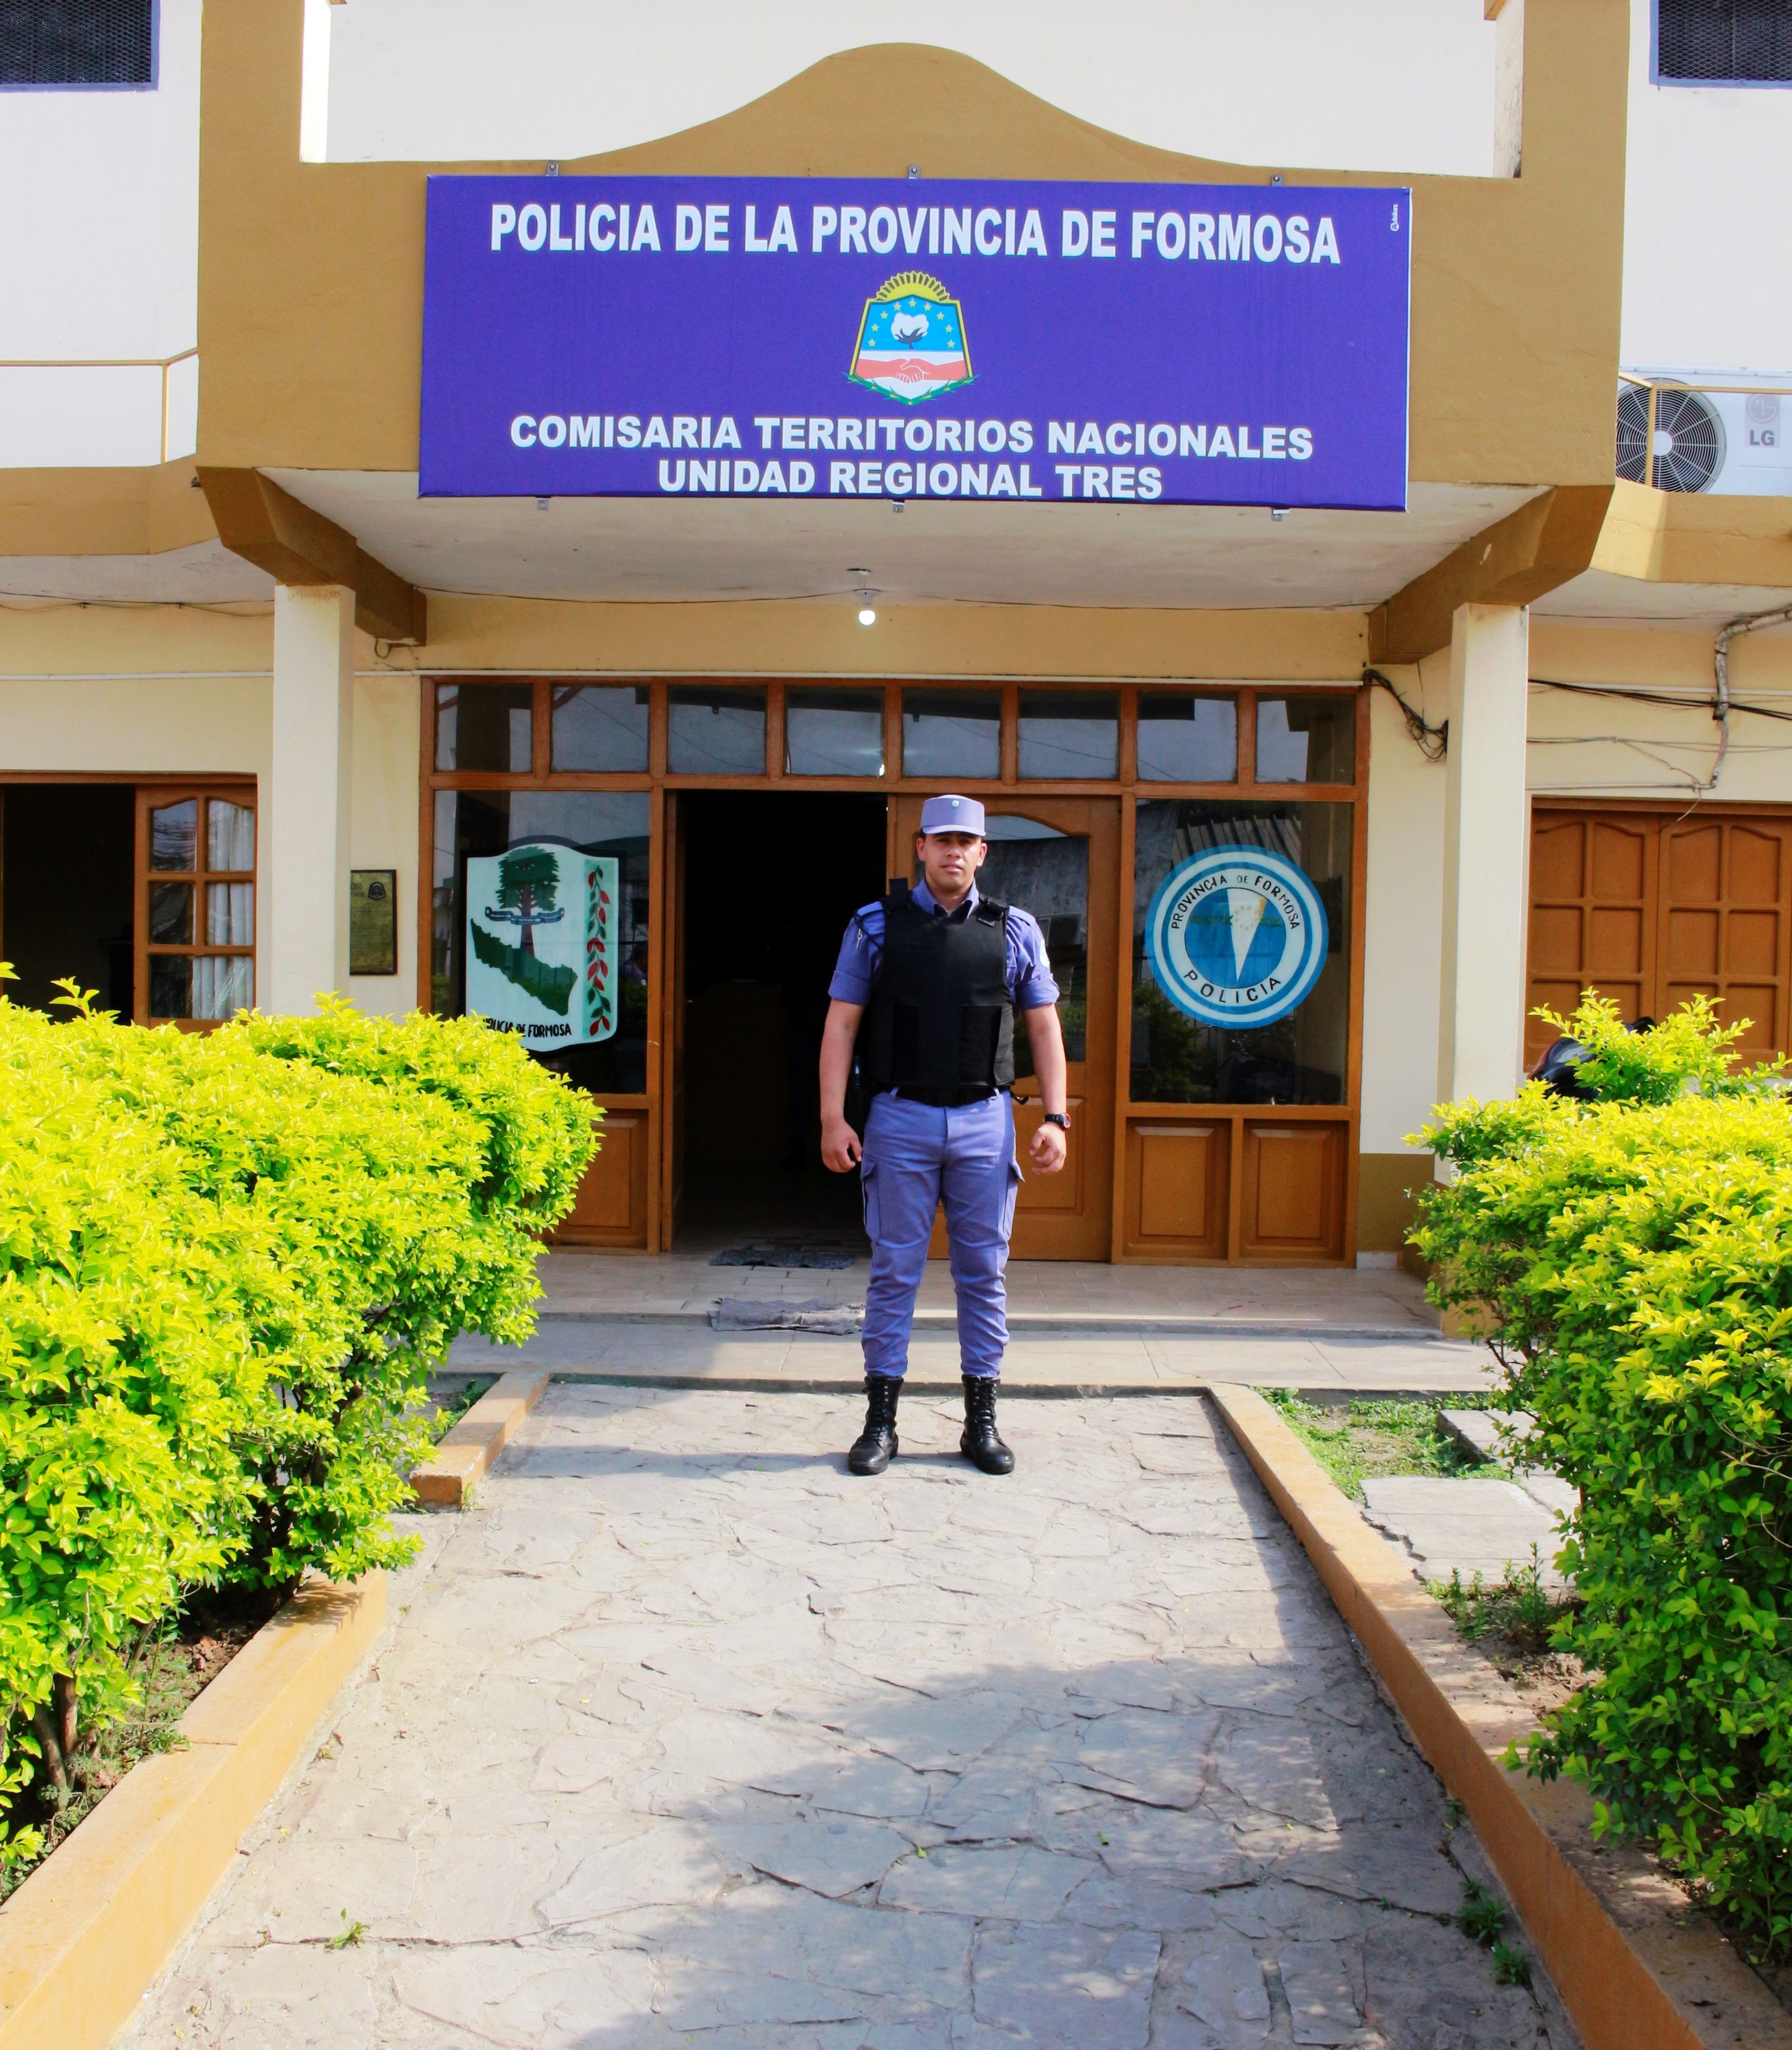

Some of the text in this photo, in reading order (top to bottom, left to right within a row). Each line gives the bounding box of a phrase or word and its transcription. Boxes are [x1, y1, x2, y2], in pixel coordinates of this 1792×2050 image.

[491, 203, 1342, 264] POLICIA DE LA PROVINCIA DE FORMOSA
[510, 414, 1313, 460] COMISARIA TERRITORIOS NACIONALES
[1749, 429, 1774, 447] LG
[658, 459, 1163, 499] UNIDAD REGIONAL TRES
[1171, 874, 1300, 930] PROVINCIA DE FORMOSA
[1183, 969, 1282, 1003] POLICIA
[516, 1023, 526, 1037] DE
[528, 1023, 572, 1038] FORMOSA
